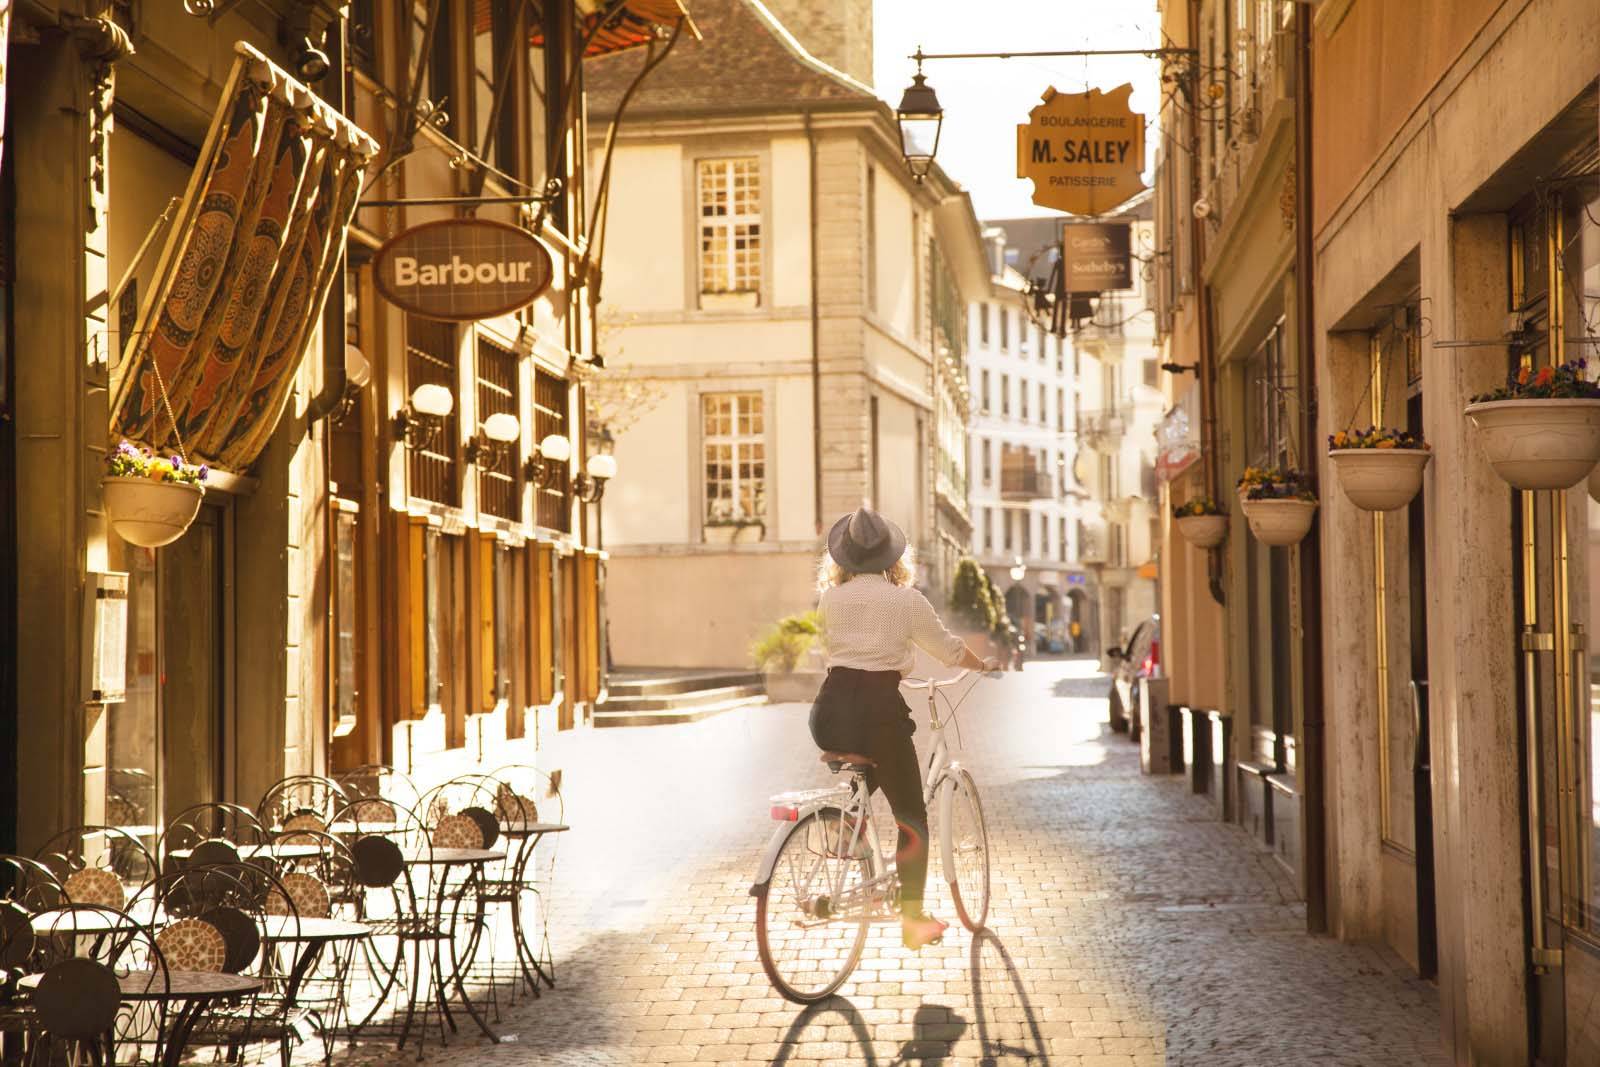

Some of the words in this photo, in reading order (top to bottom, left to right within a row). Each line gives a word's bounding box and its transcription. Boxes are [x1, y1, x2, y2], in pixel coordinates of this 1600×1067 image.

[1040, 115, 1127, 128] BOULANGERIE
[1032, 139, 1057, 163] M.
[1062, 139, 1130, 163] SALEY
[1049, 175, 1117, 186] PATISSERIE
[394, 255, 531, 287] Barbour
